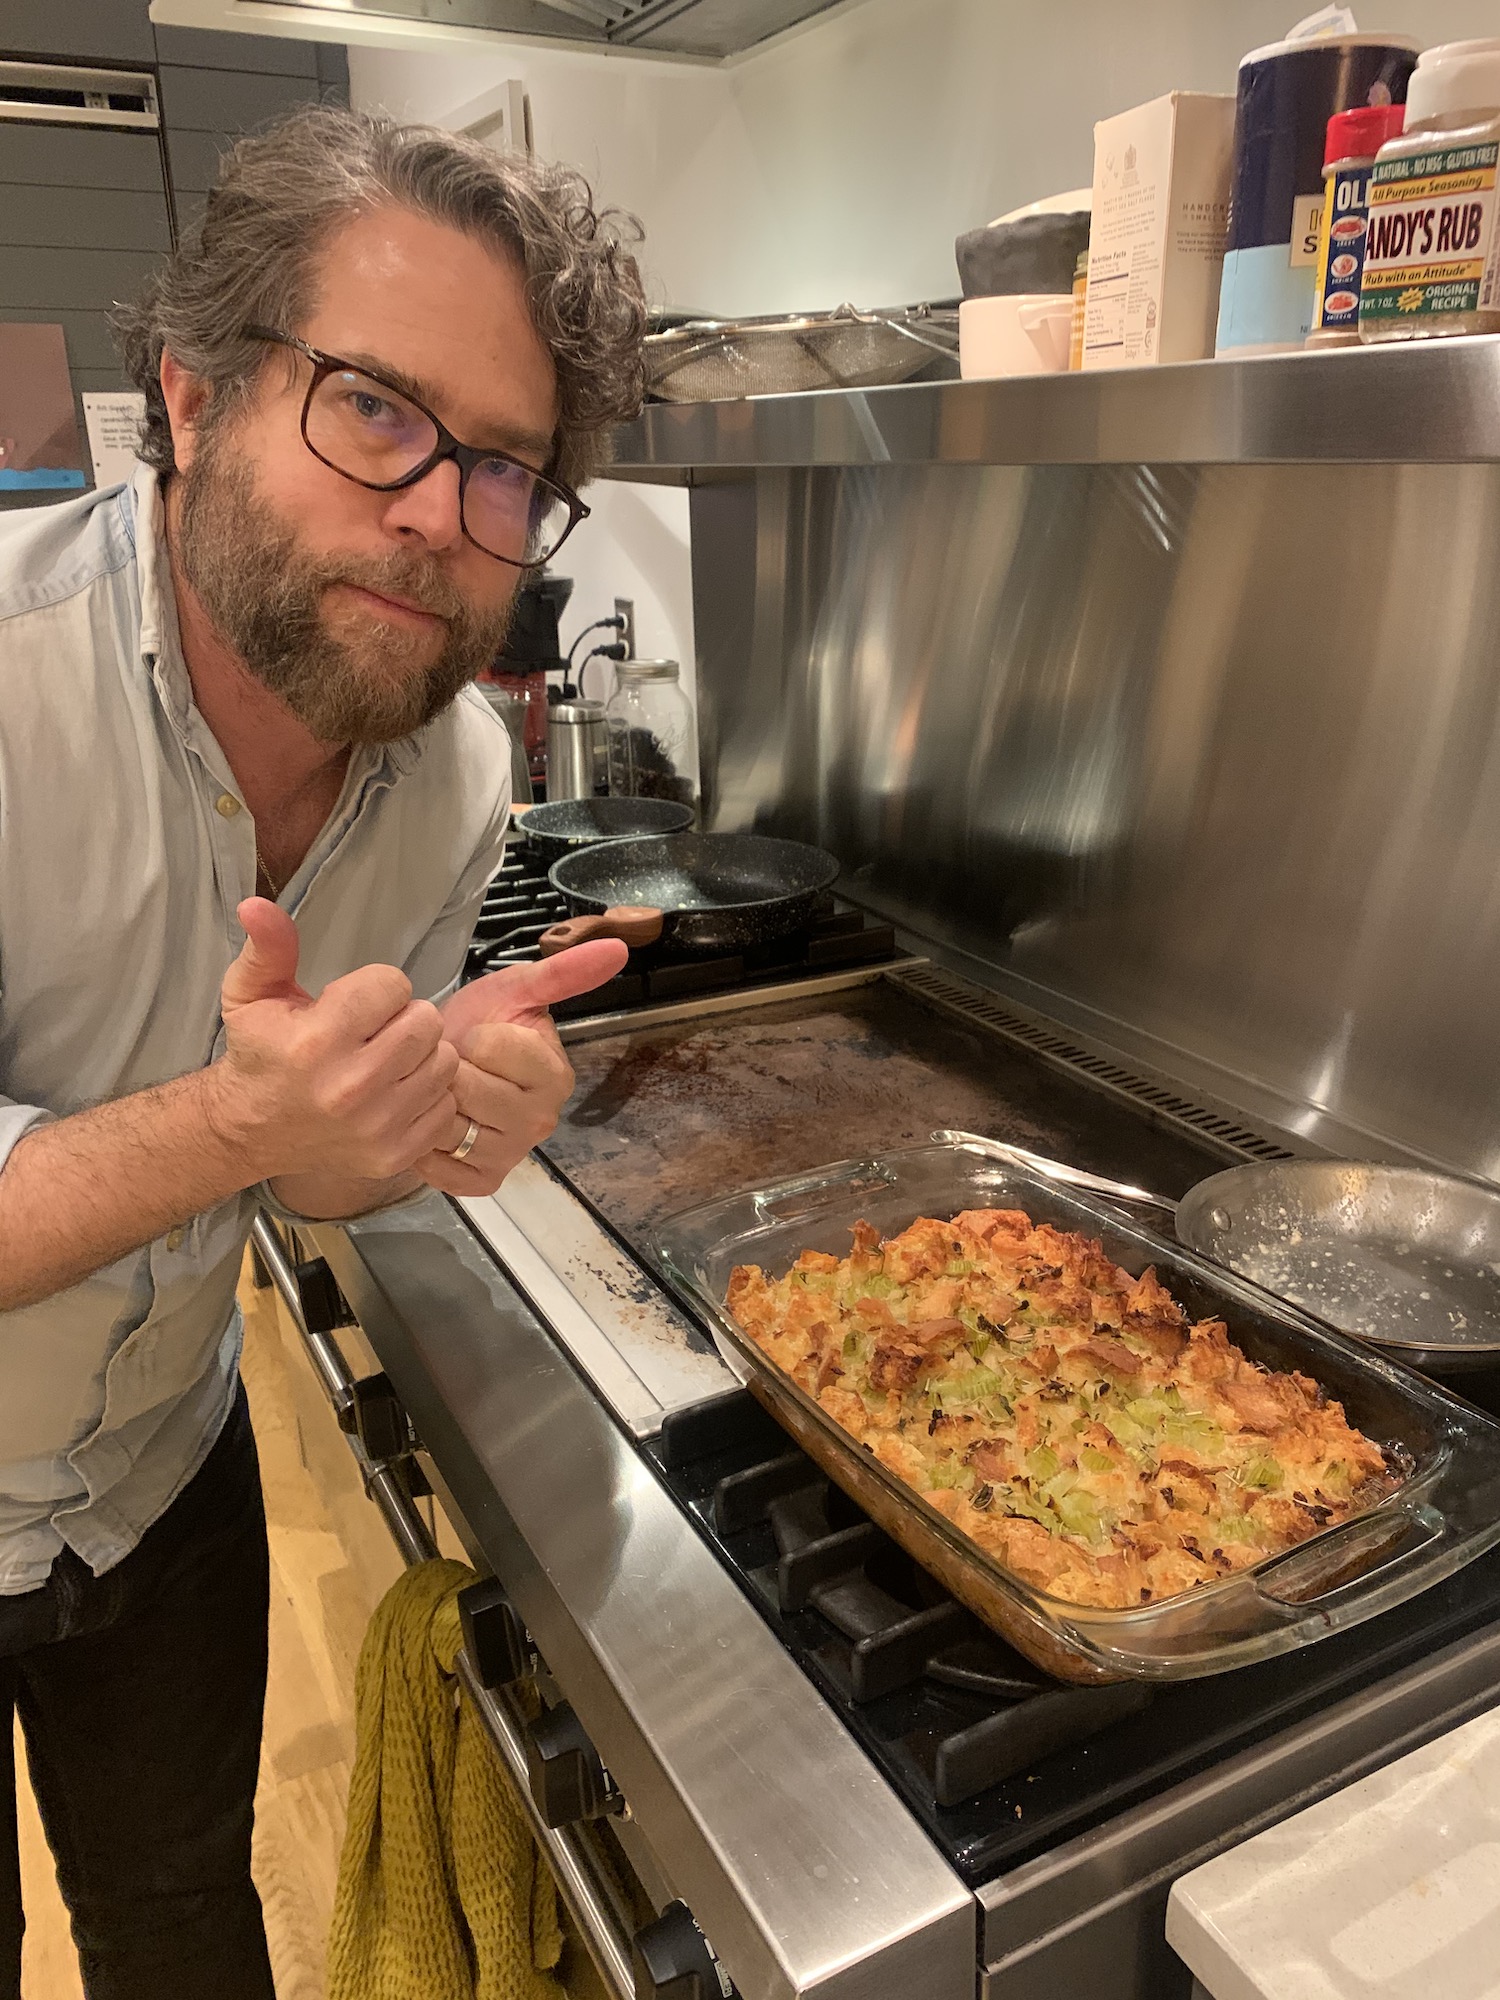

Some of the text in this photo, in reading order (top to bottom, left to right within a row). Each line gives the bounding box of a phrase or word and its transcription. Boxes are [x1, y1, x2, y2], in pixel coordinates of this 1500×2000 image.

[1379, 160, 1410, 181] NATURAL
[1414, 156, 1426, 175] NO
[1426, 154, 1443, 173] MSG
[1446, 148, 1477, 170] GLUTEN
[1477, 145, 1498, 164] FREE
[1372, 175, 1484, 201] All Purpose Seasoning
[1183, 203, 1228, 213] HANDCR
[1365, 208, 1436, 260] ANDY'S
[1437, 202, 1482, 252] RUB
[1385, 270, 1407, 283] with
[1408, 271, 1421, 280] an
[1425, 282, 1477, 298] ORIGINAL
[1430, 295, 1468, 310] RECIPE
